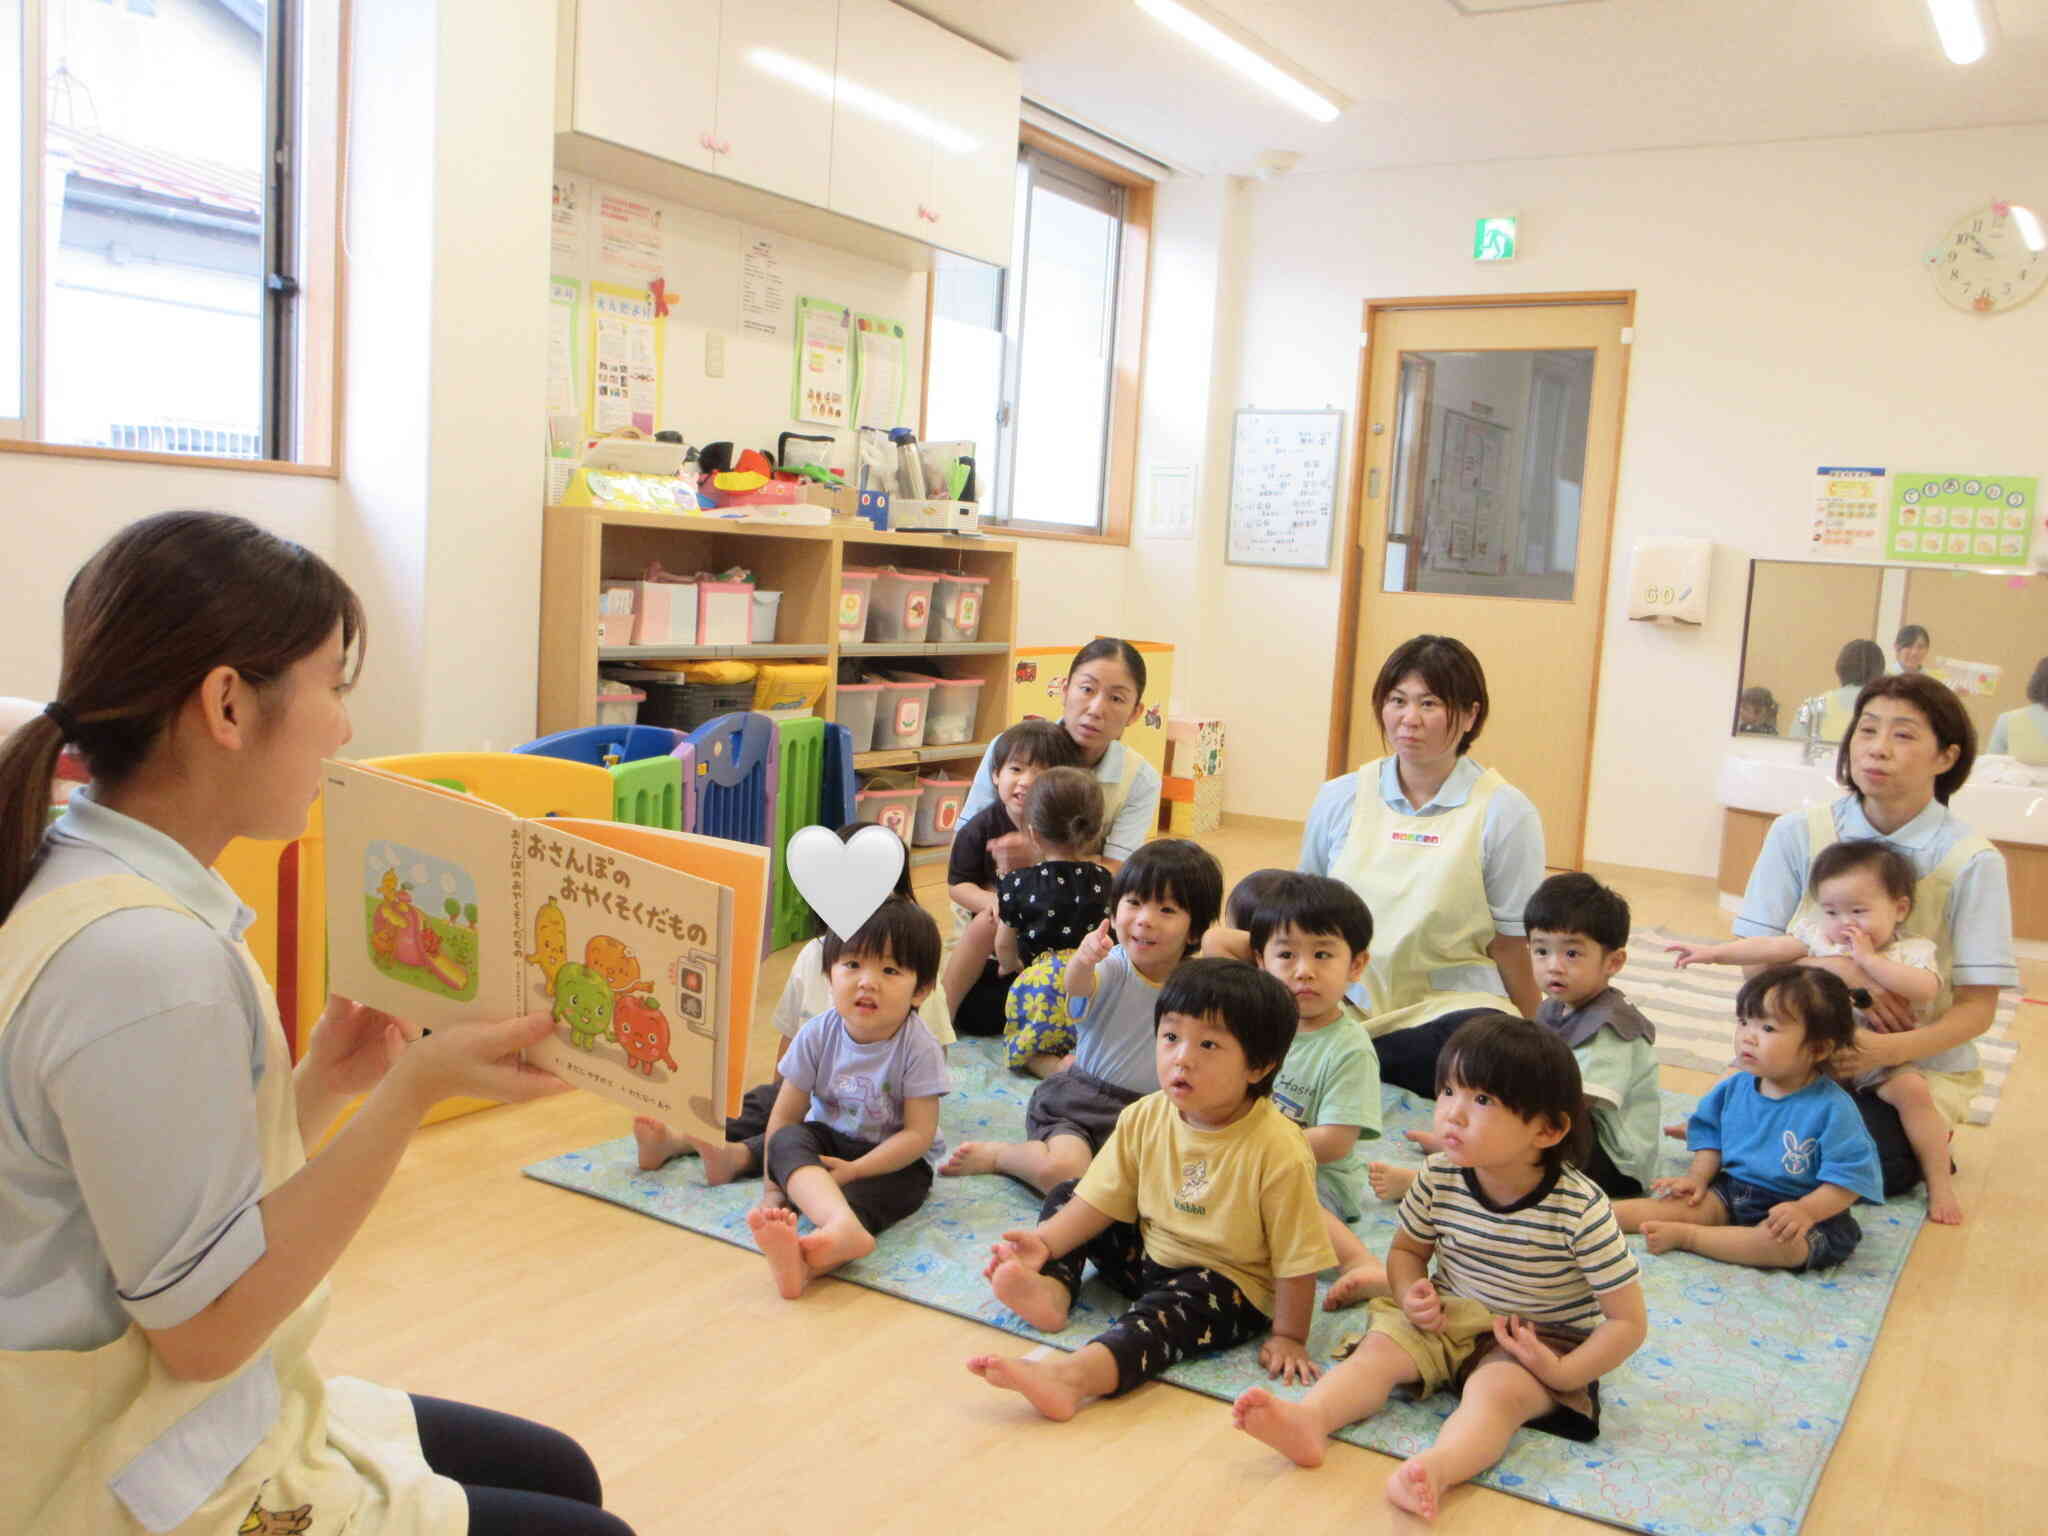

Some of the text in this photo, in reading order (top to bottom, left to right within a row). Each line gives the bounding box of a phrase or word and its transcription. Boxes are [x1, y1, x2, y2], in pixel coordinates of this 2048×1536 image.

[527, 833, 631, 888] おさんぽの
[560, 876, 707, 946] おやくそくだもの
